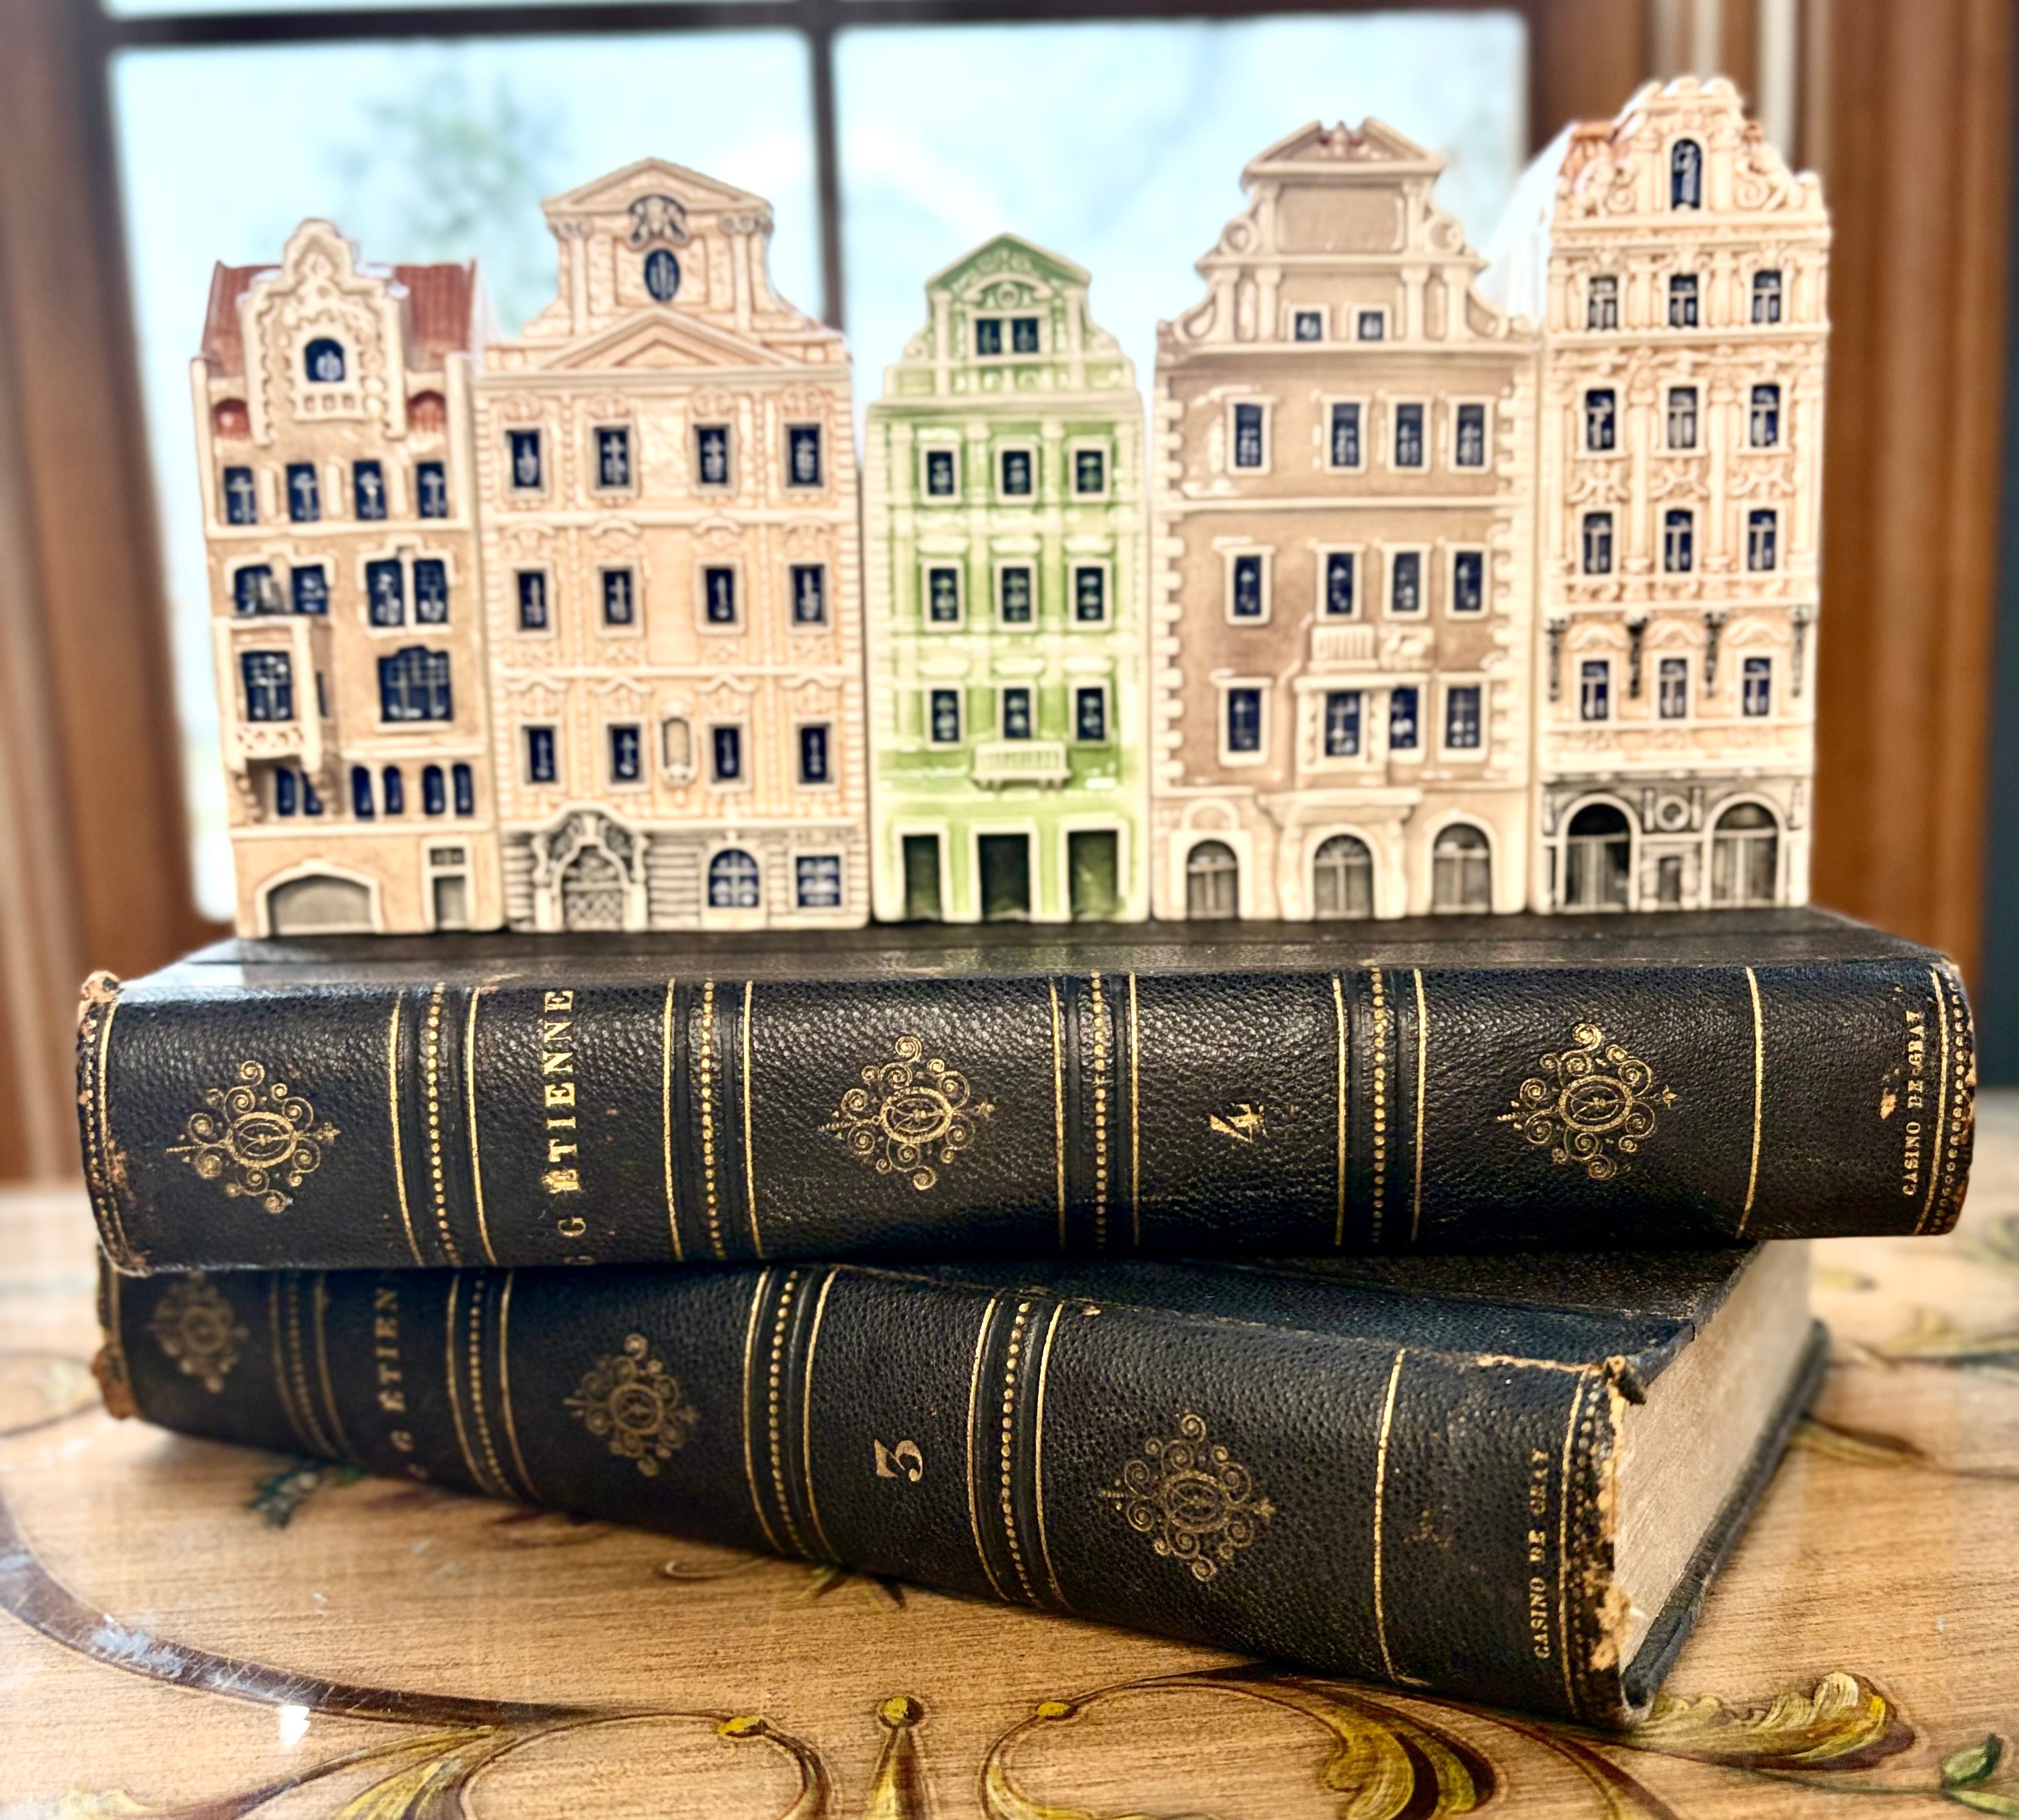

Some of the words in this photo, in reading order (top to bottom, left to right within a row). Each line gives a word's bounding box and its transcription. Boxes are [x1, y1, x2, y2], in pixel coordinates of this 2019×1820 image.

[1905, 1010, 1925, 1067] GRAY
[1907, 1080, 1923, 1109] DE
[1210, 1103, 1267, 1143] 4
[1903, 1122, 1921, 1196] CASINO
[874, 1439, 923, 1482] 3
[1529, 1529, 1546, 1563] DE
[1529, 1577, 1550, 1658] CASINO
